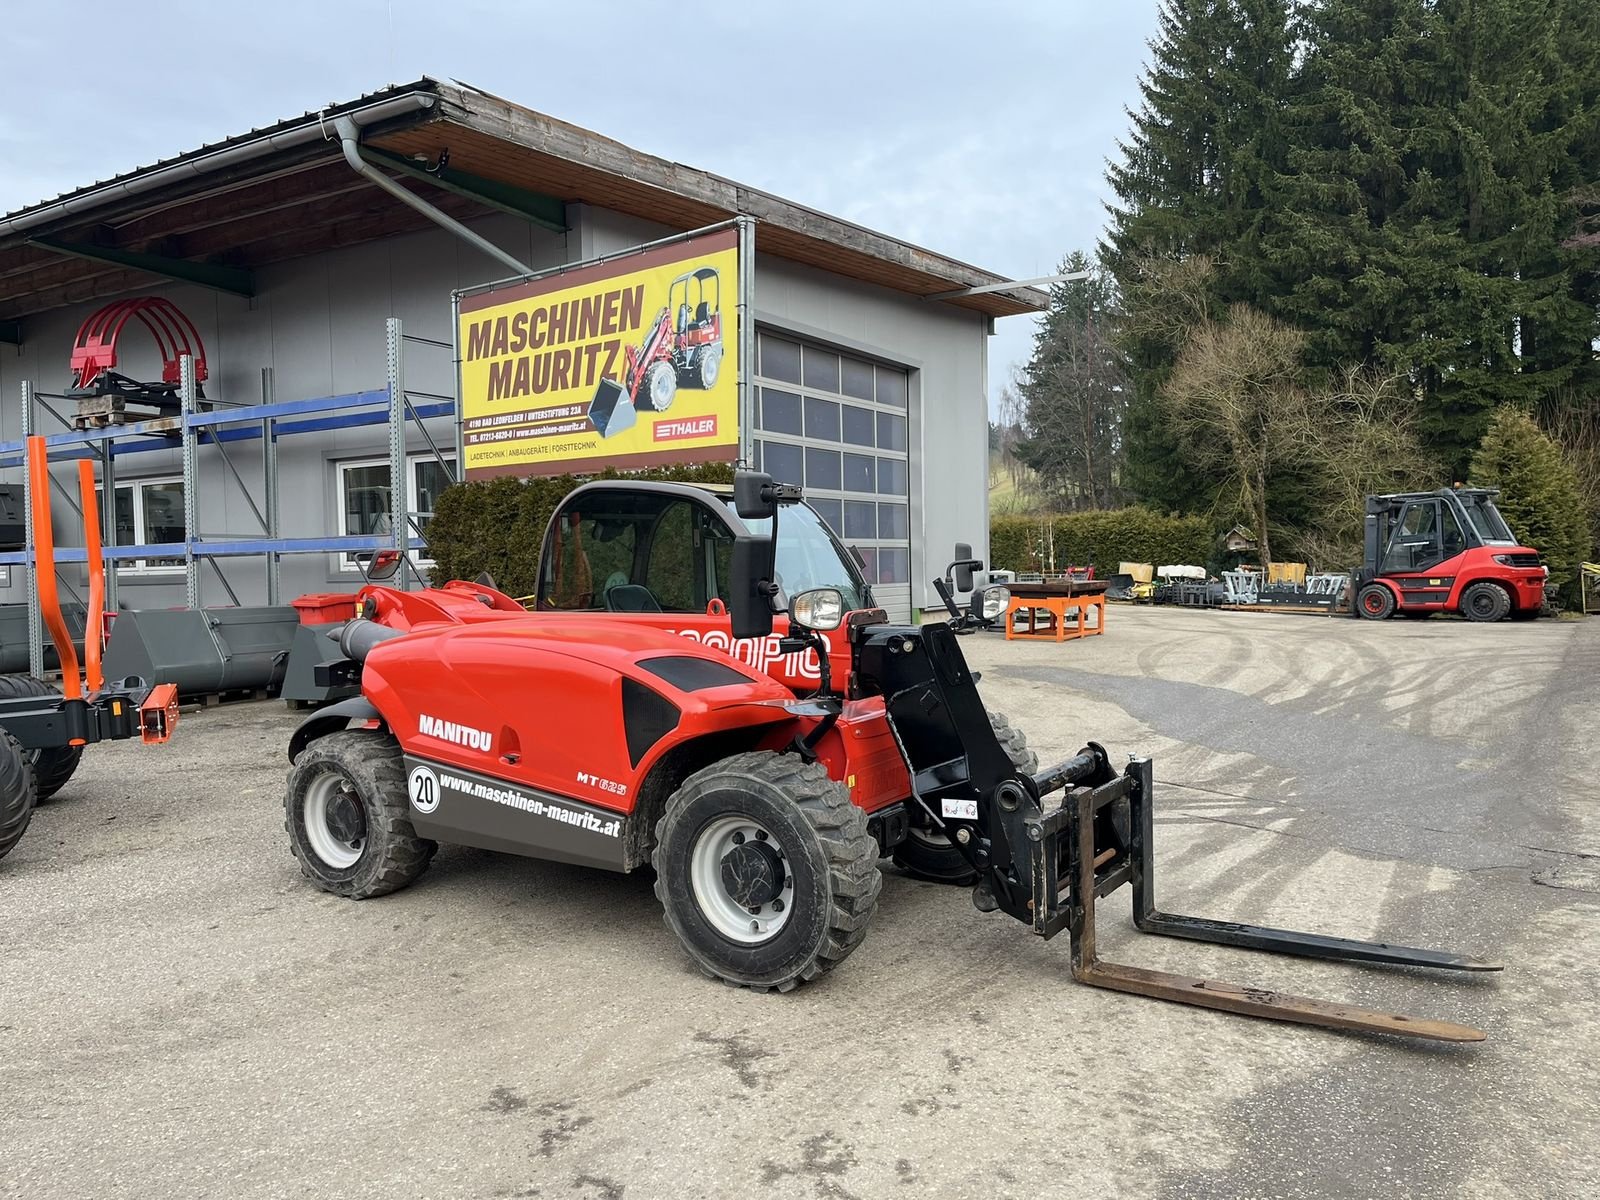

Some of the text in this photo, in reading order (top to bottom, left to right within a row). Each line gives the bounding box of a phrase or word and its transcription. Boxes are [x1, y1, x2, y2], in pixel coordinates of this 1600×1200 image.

[467, 284, 645, 362] MASCHINEN
[487, 339, 621, 401] MAURITZ
[482, 417, 492, 427] BAD
[516, 421, 586, 438] www.maschinen-mauritz.at
[671, 420, 714, 435] THALER
[470, 450, 505, 461] LADETECHNIK
[508, 445, 548, 457] ANBAUGERÄTE
[552, 441, 597, 453] FORSTTECHNIK
[419, 714, 492, 751] MANITOU
[415, 774, 433, 805] 20
[440, 773, 621, 838] www.maschinen-mauritz.at
